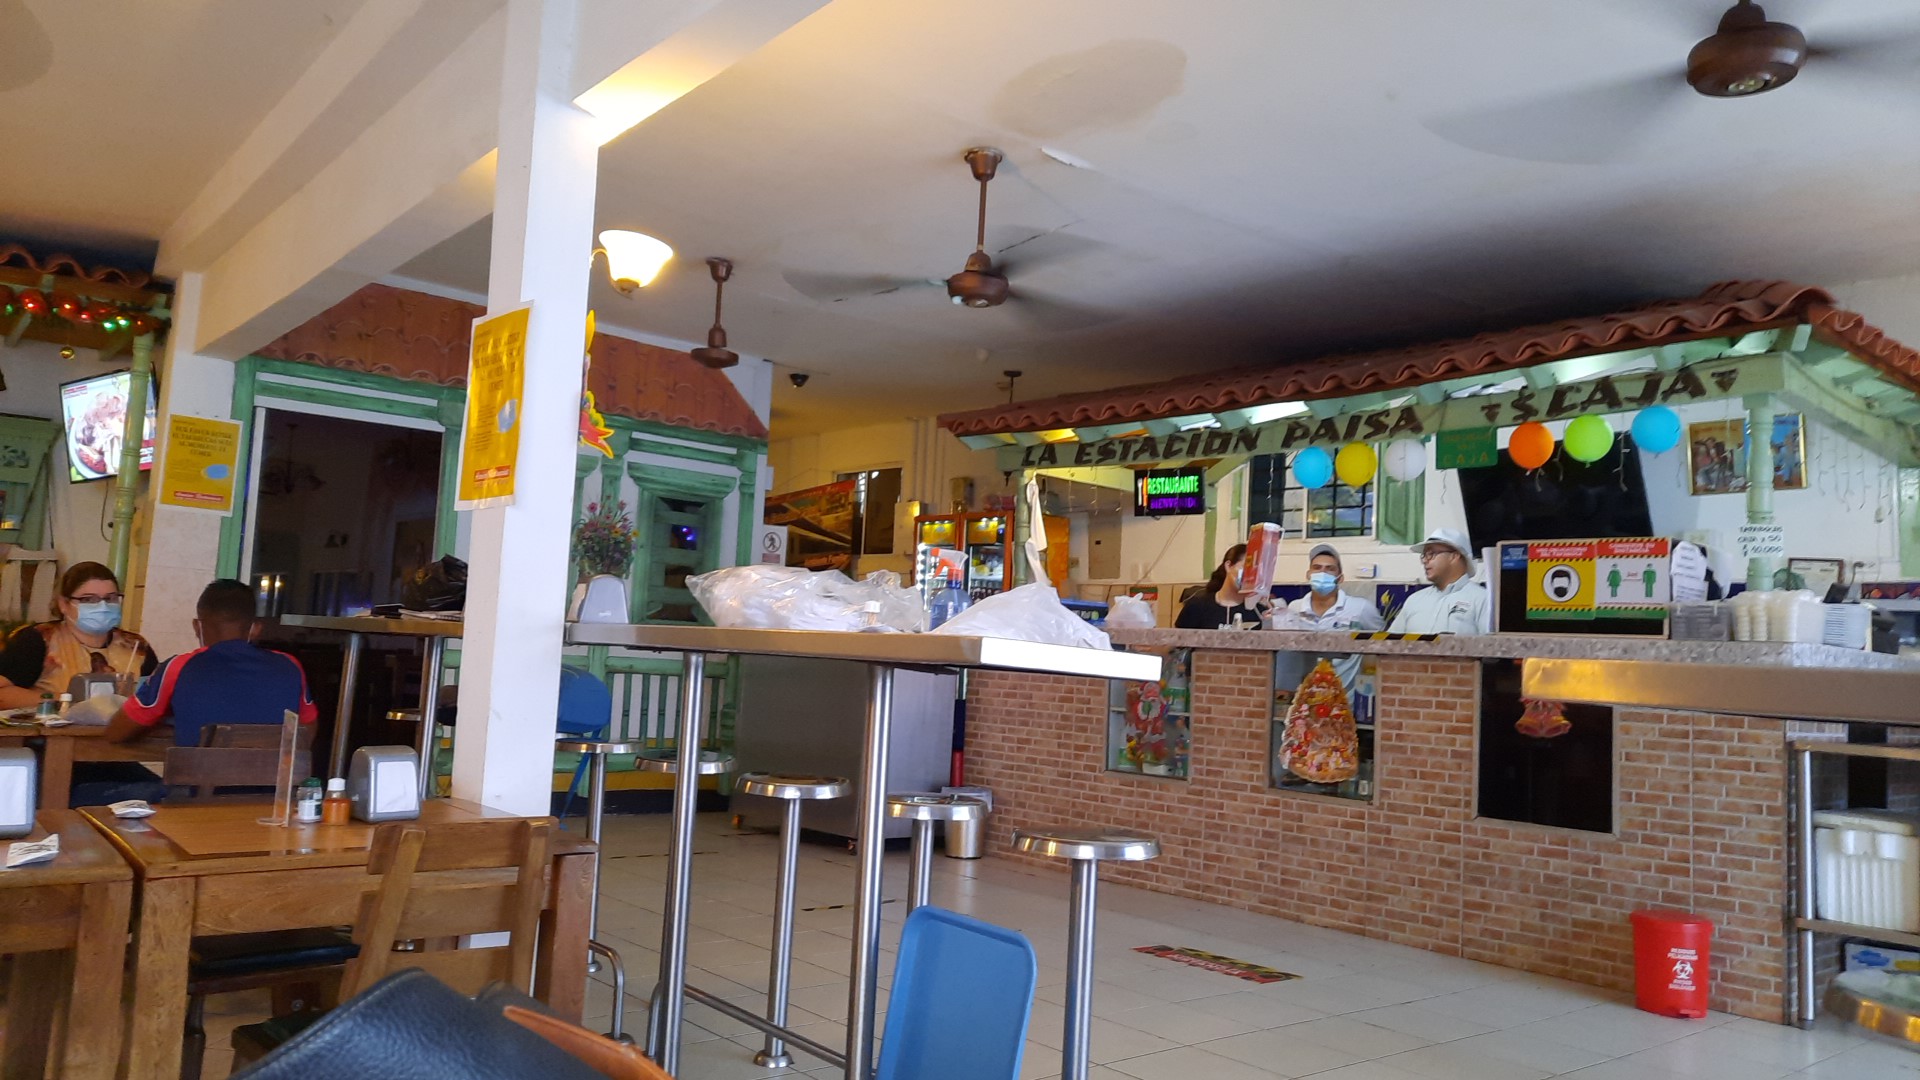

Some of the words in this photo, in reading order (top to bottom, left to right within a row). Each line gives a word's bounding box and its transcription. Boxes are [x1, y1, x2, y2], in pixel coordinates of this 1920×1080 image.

[1545, 365, 1707, 417] CAJA
[1021, 443, 1058, 467] LA
[1074, 427, 1262, 464] ESTACION
[1280, 404, 1425, 449] PAISA
[1148, 475, 1199, 495] RESTAURANTE
